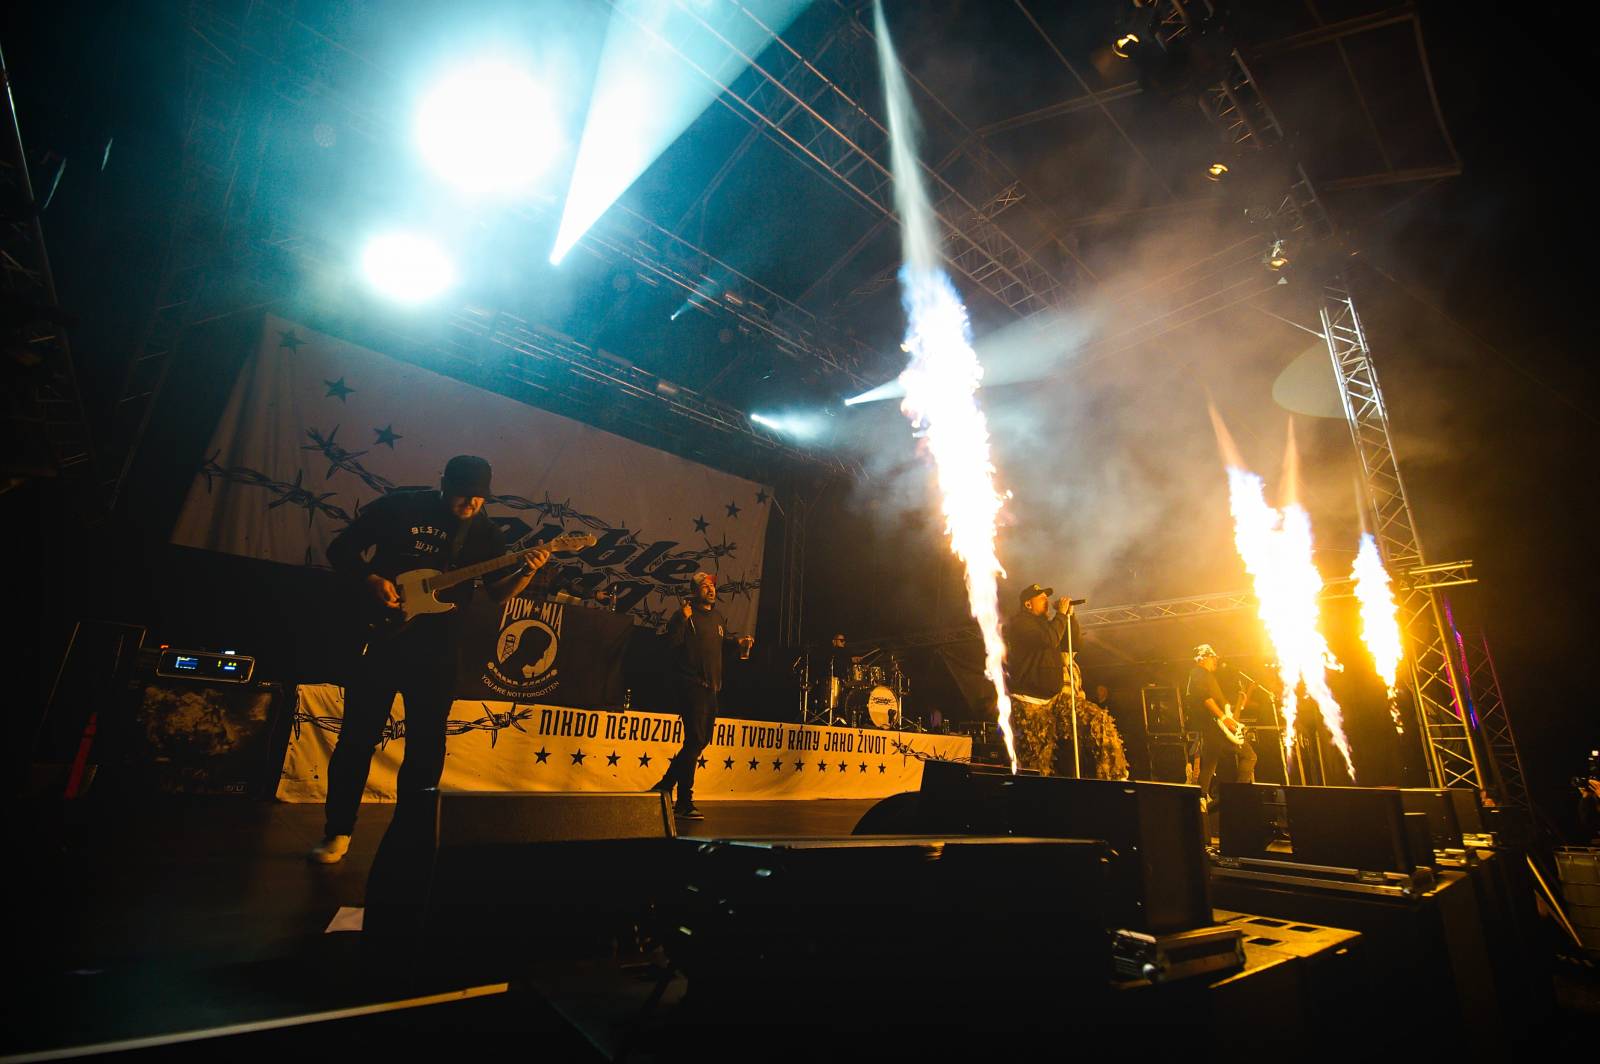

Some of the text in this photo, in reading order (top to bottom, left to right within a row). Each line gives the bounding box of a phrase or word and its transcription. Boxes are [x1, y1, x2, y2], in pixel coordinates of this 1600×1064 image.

[499, 597, 564, 640] POW MIA
[481, 674, 495, 688] YOU
[523, 680, 560, 698] FORGOTTEN
[539, 709, 599, 738] NIKDO
[605, 714, 684, 744] NEROZDÁ
[741, 724, 783, 750] TVRDÝ
[788, 724, 821, 751] RÁNY
[824, 731, 854, 753] JAKO
[857, 729, 888, 755] ŽIVOT
